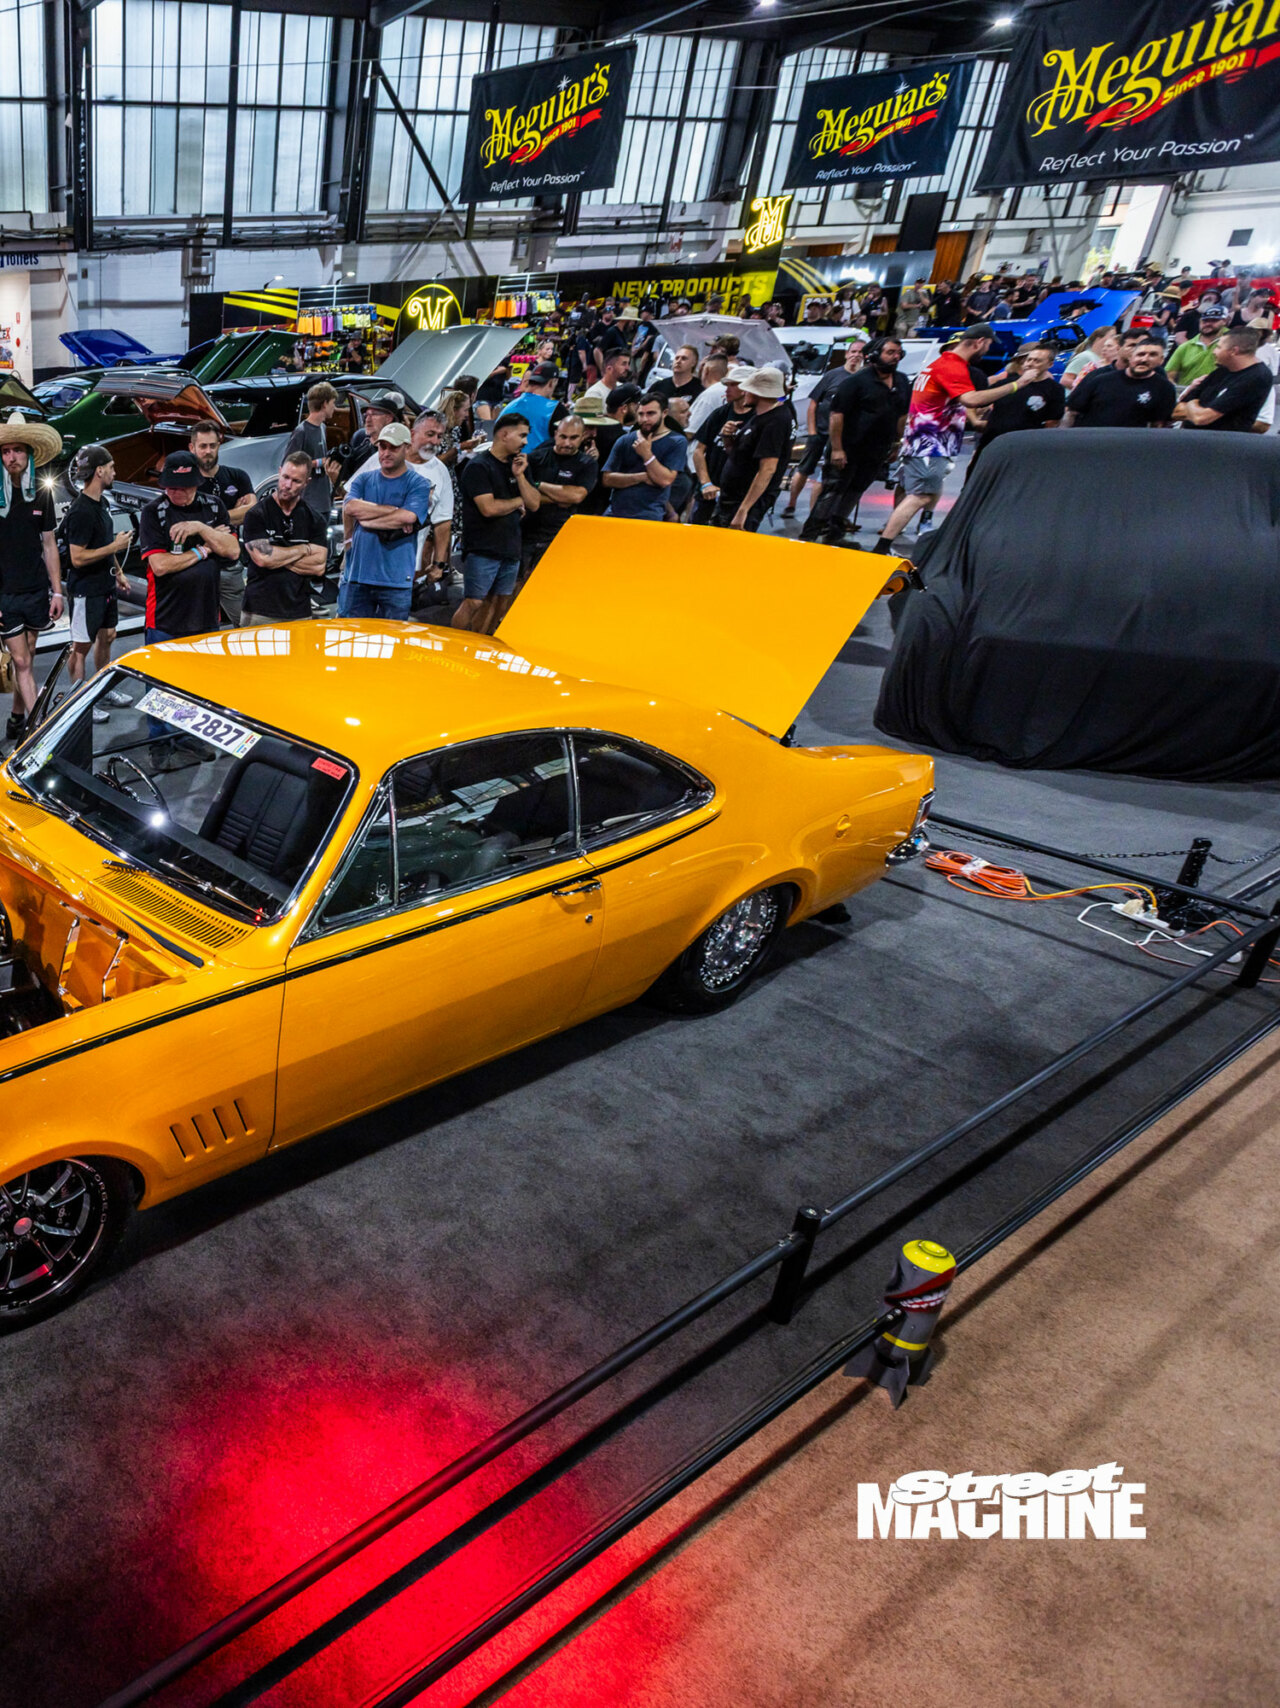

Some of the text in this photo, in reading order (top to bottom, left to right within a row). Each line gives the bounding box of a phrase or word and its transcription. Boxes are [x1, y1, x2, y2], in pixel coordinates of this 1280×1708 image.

[1161, 52, 1247, 106] Since 1901
[480, 62, 611, 169] Meguiar's
[809, 72, 951, 160] Meguiar's
[541, 117, 577, 151] Since 1901
[815, 168, 850, 181] Reflect
[851, 164, 872, 176] Your
[1038, 153, 1107, 174] Reflect
[1113, 146, 1156, 163] Your
[490, 179, 520, 195] Reflect
[522, 175, 542, 188] Your
[745, 194, 793, 254] M
[190, 713, 246, 747] 2827
